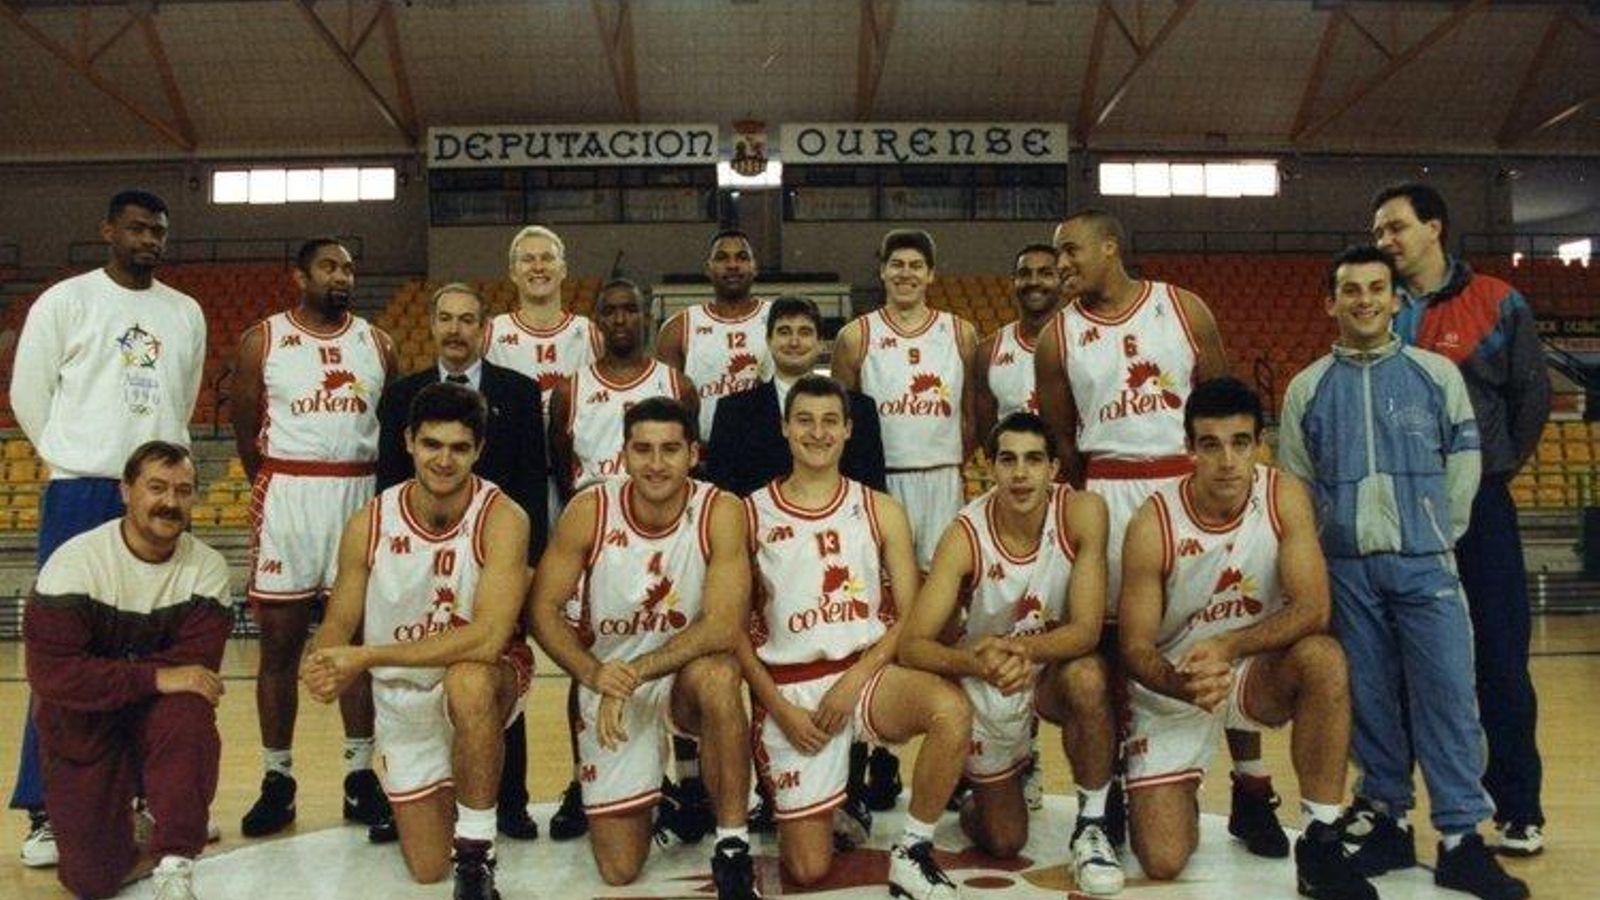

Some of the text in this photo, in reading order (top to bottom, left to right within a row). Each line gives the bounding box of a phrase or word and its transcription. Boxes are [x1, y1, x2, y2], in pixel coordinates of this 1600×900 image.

[433, 127, 1052, 162] DEPUTACION OURENSE
[727, 332, 746, 349] 12
[1123, 334, 1138, 357] 6
[318, 347, 342, 364] 15
[536, 344, 557, 363] 14
[908, 348, 921, 364] 9
[816, 530, 840, 557] 13
[434, 550, 455, 576] 10
